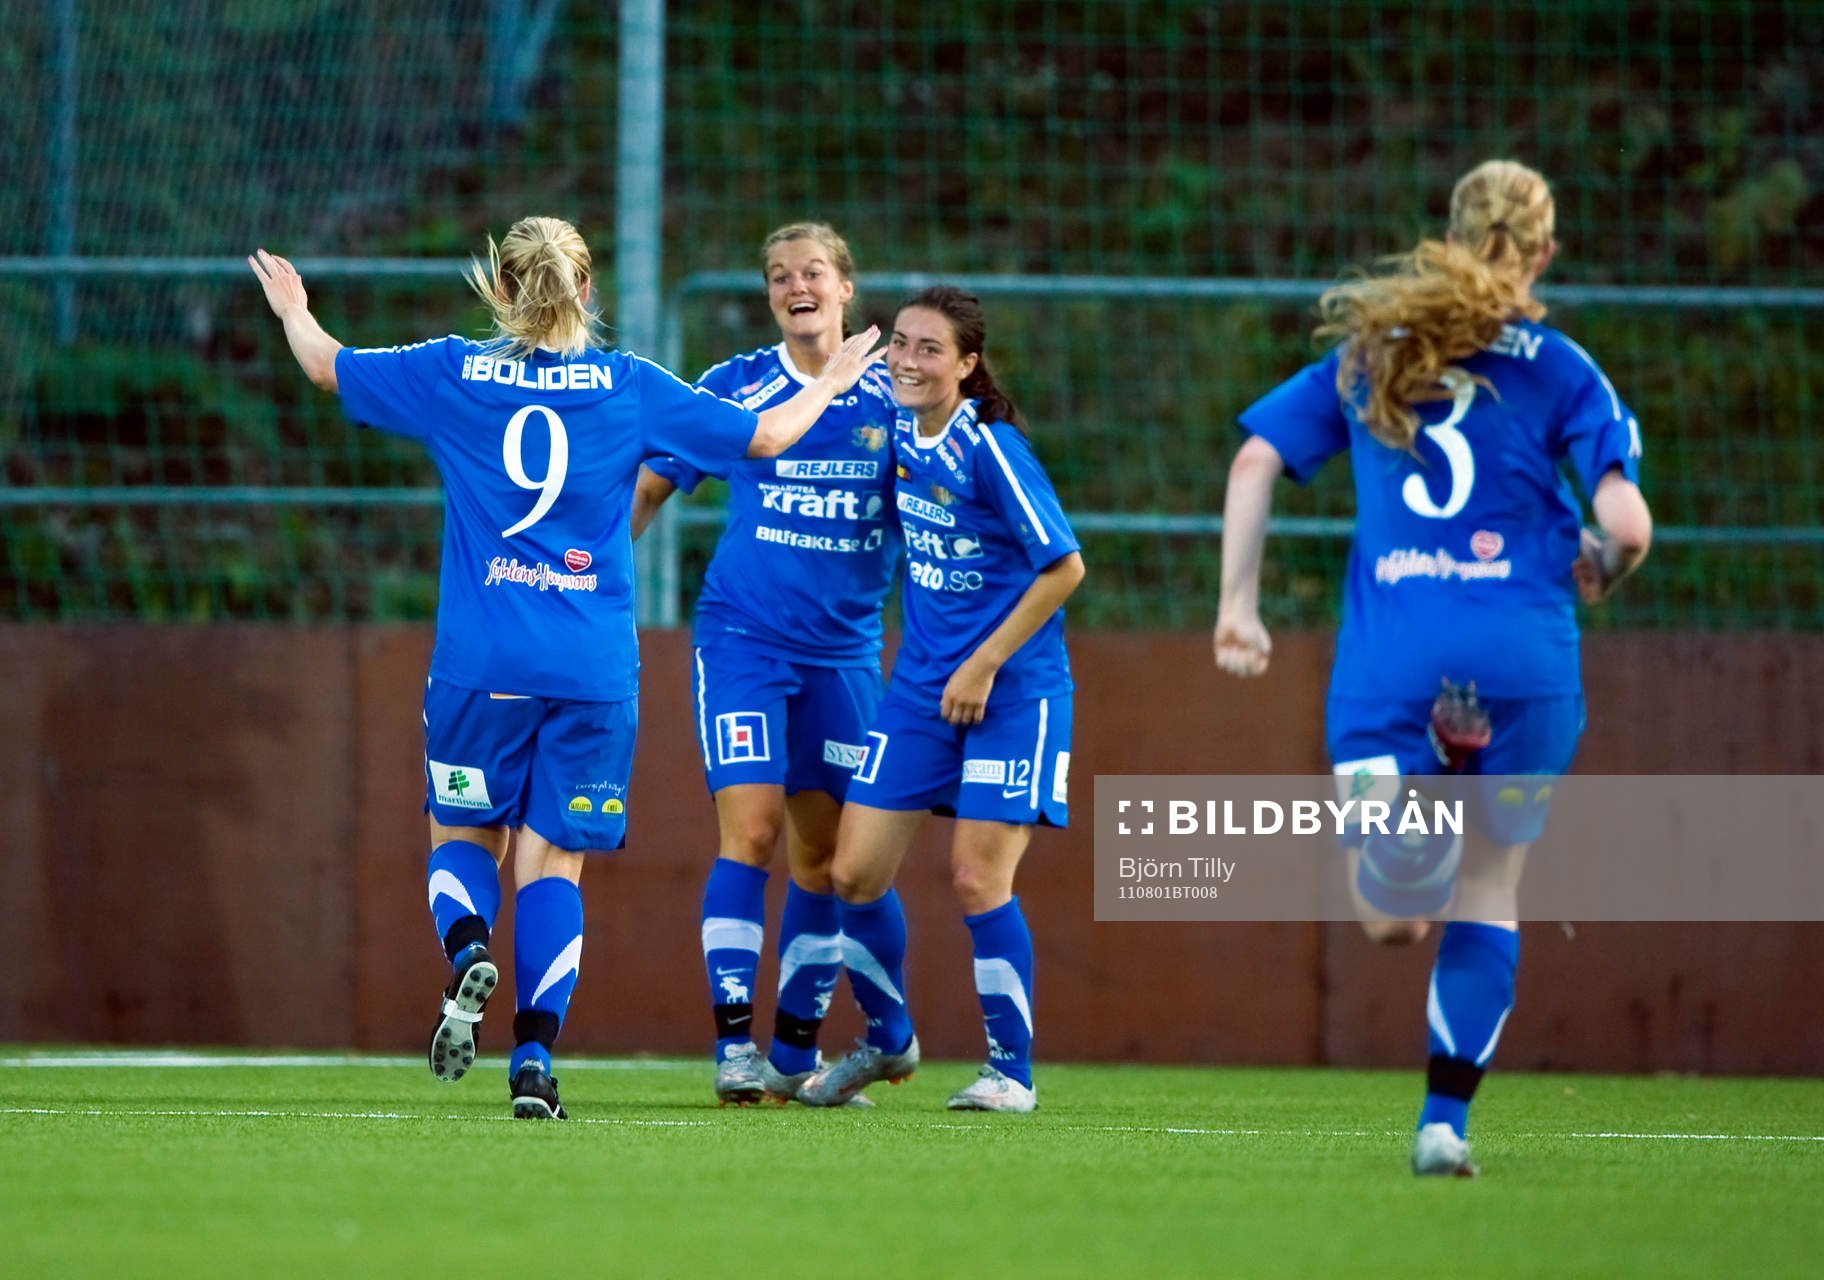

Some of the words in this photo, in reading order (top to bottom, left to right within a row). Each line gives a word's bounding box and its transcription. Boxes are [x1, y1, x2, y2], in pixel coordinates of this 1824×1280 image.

[471, 355, 613, 390] BOLIDEN
[1402, 366, 1476, 518] 3
[502, 405, 568, 538] 9
[796, 462, 876, 477] REJLERS
[906, 497, 951, 523] REJLERS
[903, 529, 949, 559] raft
[909, 558, 983, 592] eto.se
[1006, 759, 1030, 787] 12
